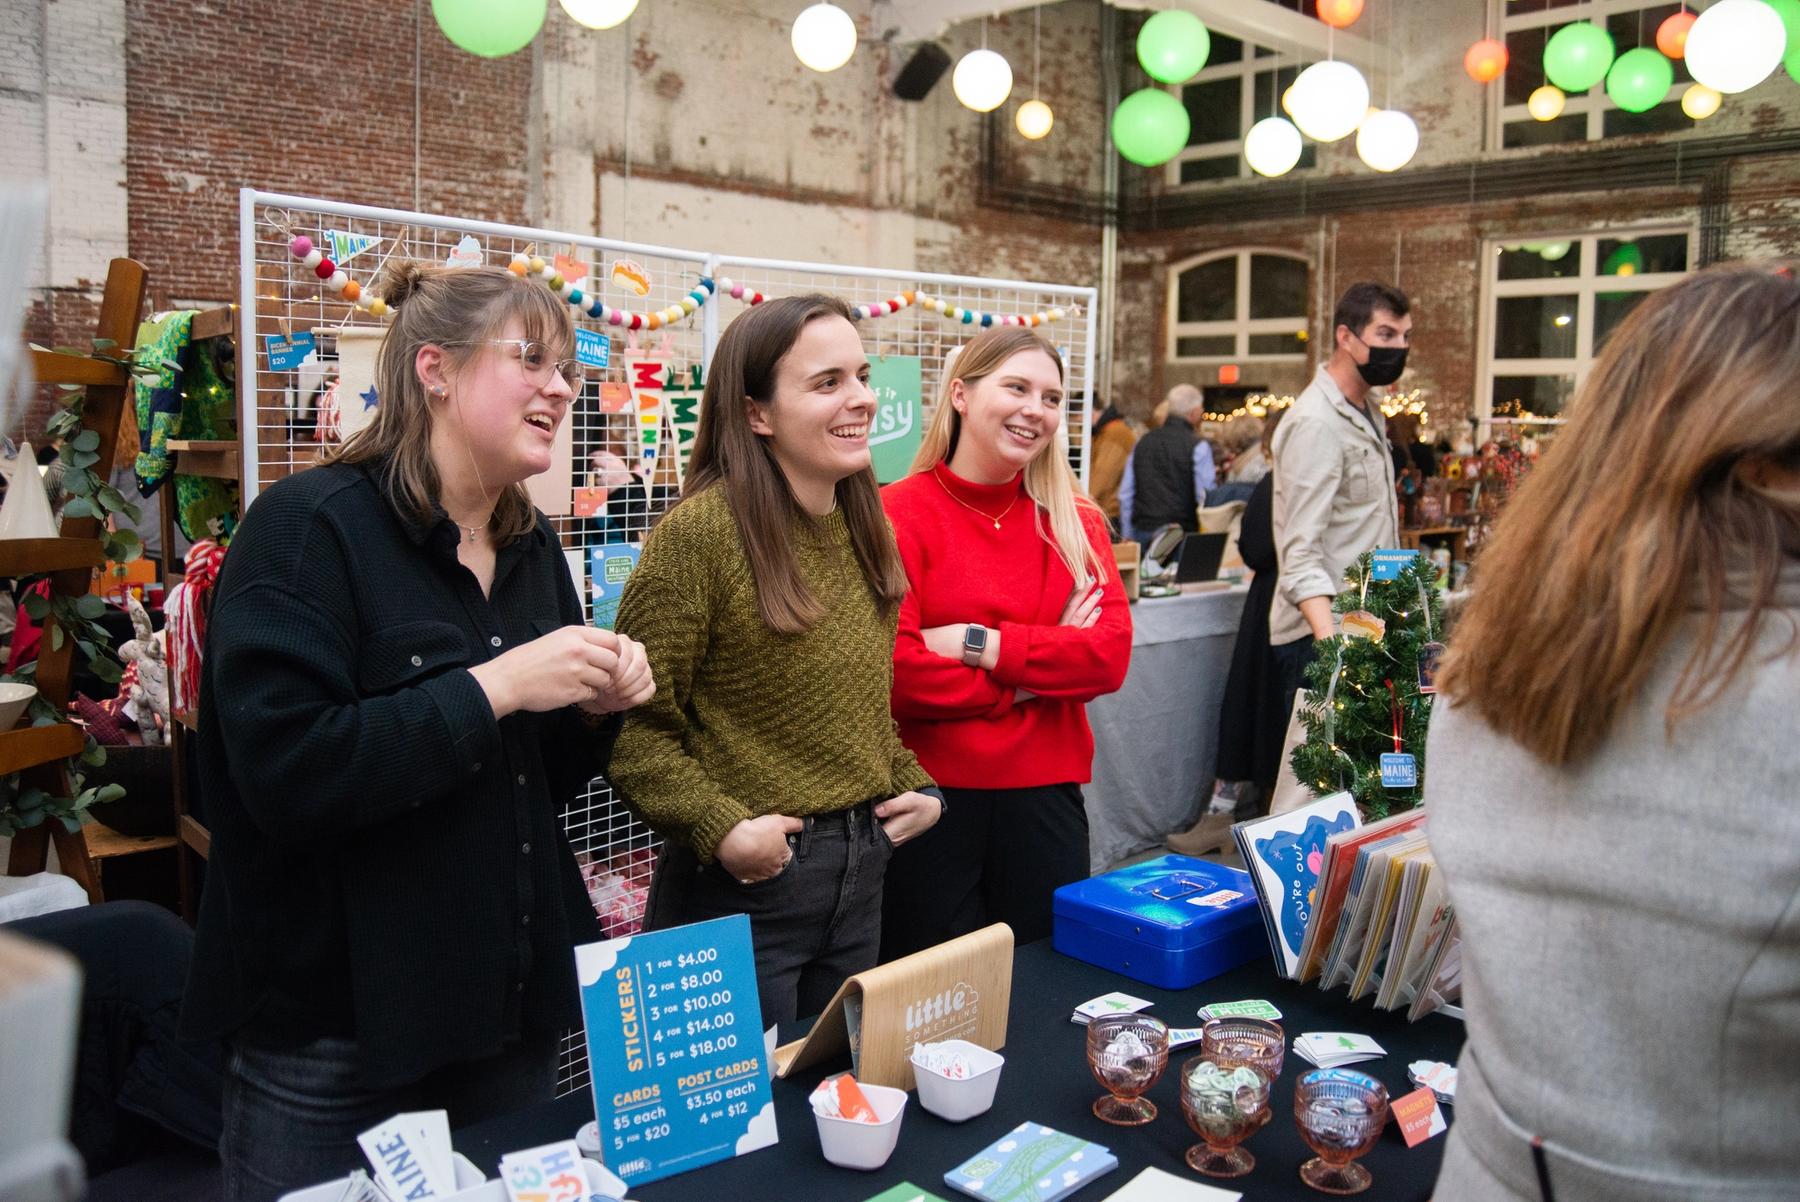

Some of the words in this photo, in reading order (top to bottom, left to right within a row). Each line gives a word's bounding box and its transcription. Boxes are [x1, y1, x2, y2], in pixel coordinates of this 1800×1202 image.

[336, 234, 369, 257] MAINE
[272, 357, 286, 365] $20
[633, 363, 663, 459] MAINE
[1383, 765, 1413, 777] MAINE
[645, 962, 653, 975] 1
[658, 960, 673, 969] FOR
[677, 947, 718, 969] $4.00
[648, 984, 658, 998] 2
[661, 982, 675, 991] FOR
[680, 969, 723, 991] $8.00
[616, 966, 644, 1073] STICKERS
[650, 1006, 660, 1021] 3
[664, 1005, 678, 1014] FOR
[683, 990, 732, 1014] $10.00
[905, 989, 966, 1032] little
[653, 1030, 663, 1044] 4
[667, 1027, 681, 1037] FOR
[686, 1012, 735, 1037] $14.00
[904, 1004, 978, 1044] SOMETHING
[656, 1053, 666, 1067] 5
[669, 1050, 684, 1060] FOR
[689, 1034, 738, 1059] $18.00
[677, 1070, 712, 1090] POST
[715, 1058, 759, 1080] CARDS
[613, 1084, 661, 1107] CARDS
[686, 1090, 722, 1111] $3.50
[725, 1081, 756, 1100] each
[613, 1115, 630, 1131] $5
[633, 1106, 666, 1125] each
[699, 1113, 709, 1125] 4
[711, 1109, 724, 1120] FOR
[727, 1101, 748, 1119] $12
[614, 1136, 624, 1151] 5
[626, 1134, 640, 1143] FOR
[644, 1123, 670, 1142] $20
